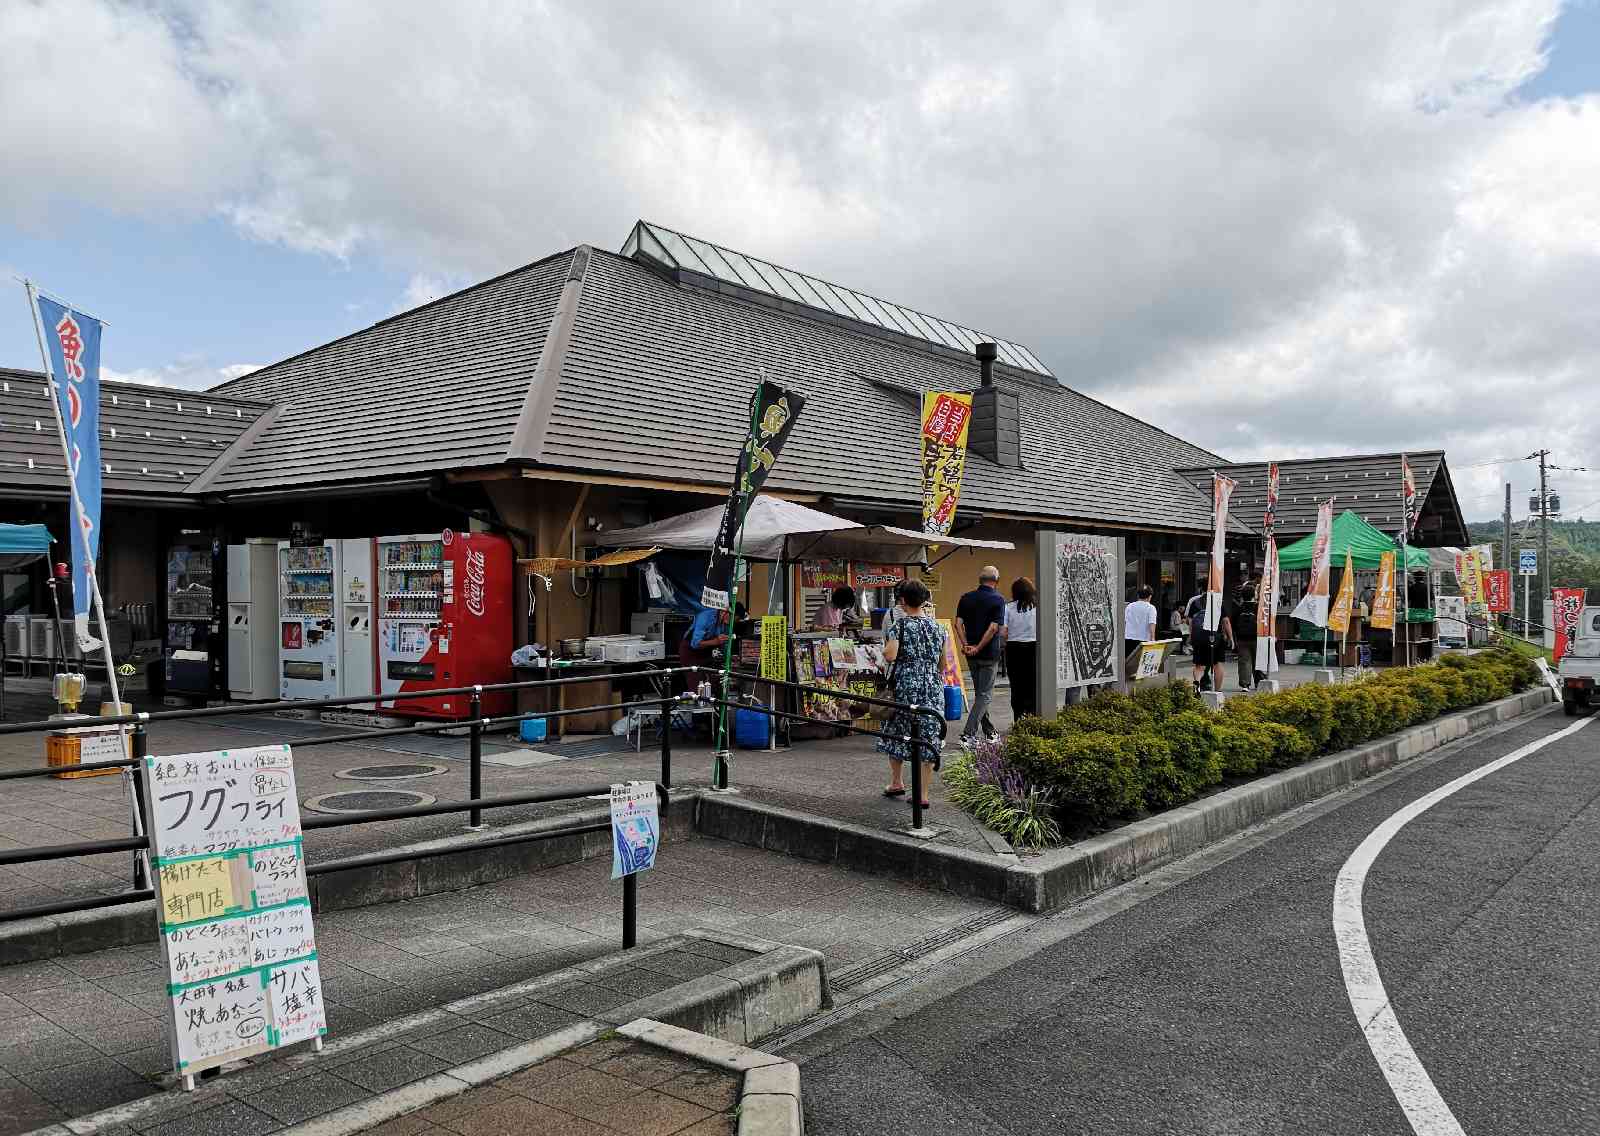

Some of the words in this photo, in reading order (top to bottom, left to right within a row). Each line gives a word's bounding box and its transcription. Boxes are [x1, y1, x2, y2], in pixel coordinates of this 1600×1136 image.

[466, 546, 485, 616] Coca-Cola
[159, 778, 238, 832] フグ
[231, 797, 286, 823] フライ
